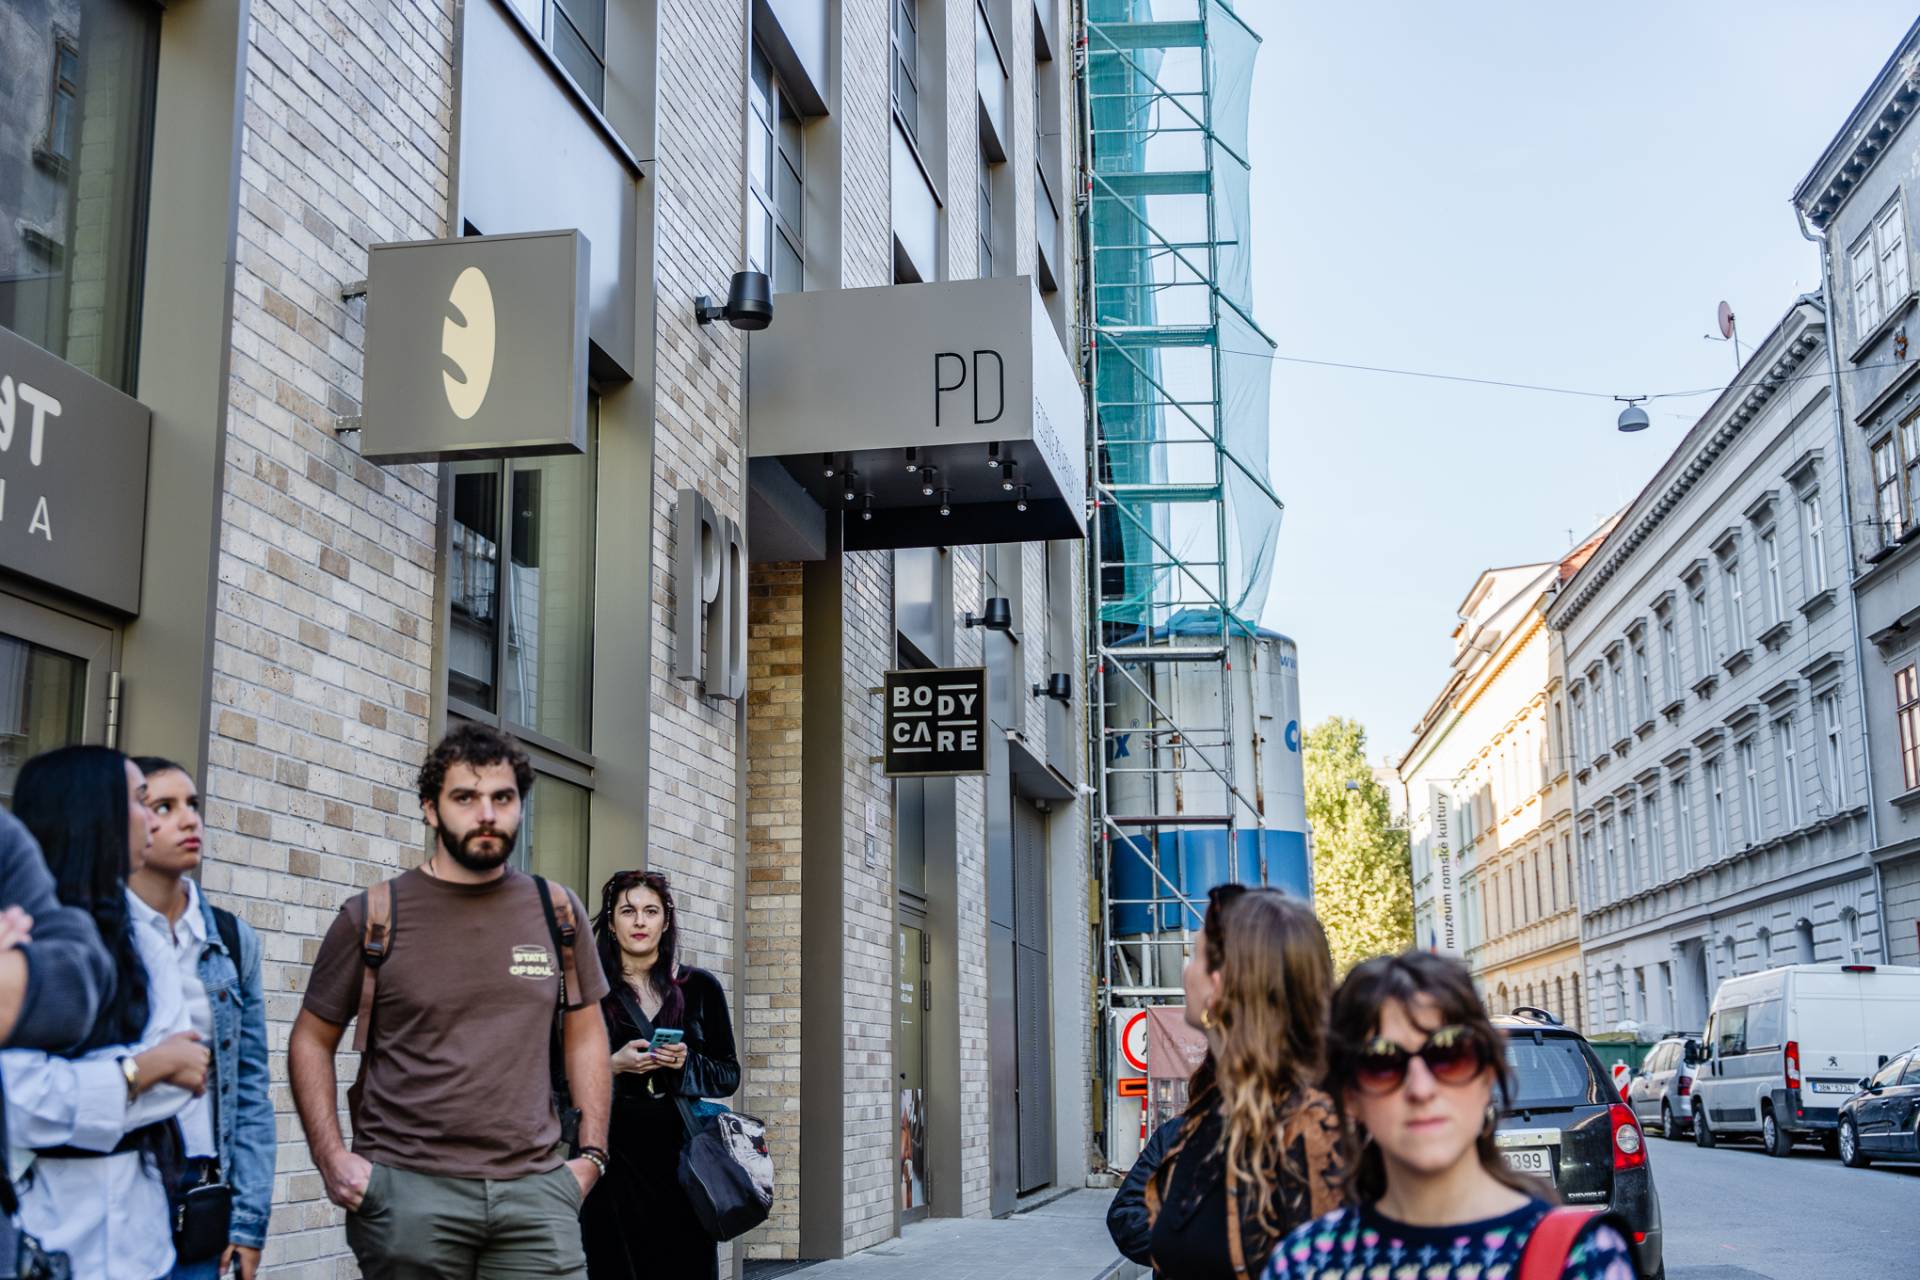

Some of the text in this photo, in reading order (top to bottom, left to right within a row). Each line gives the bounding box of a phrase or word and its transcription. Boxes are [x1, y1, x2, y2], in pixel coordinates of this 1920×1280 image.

[935, 350, 1004, 427] PD
[676, 488, 747, 700] PD
[893, 686, 977, 716] BODY
[893, 721, 977, 751] CARE
[1437, 792, 1454, 949] muzeum romské kultury
